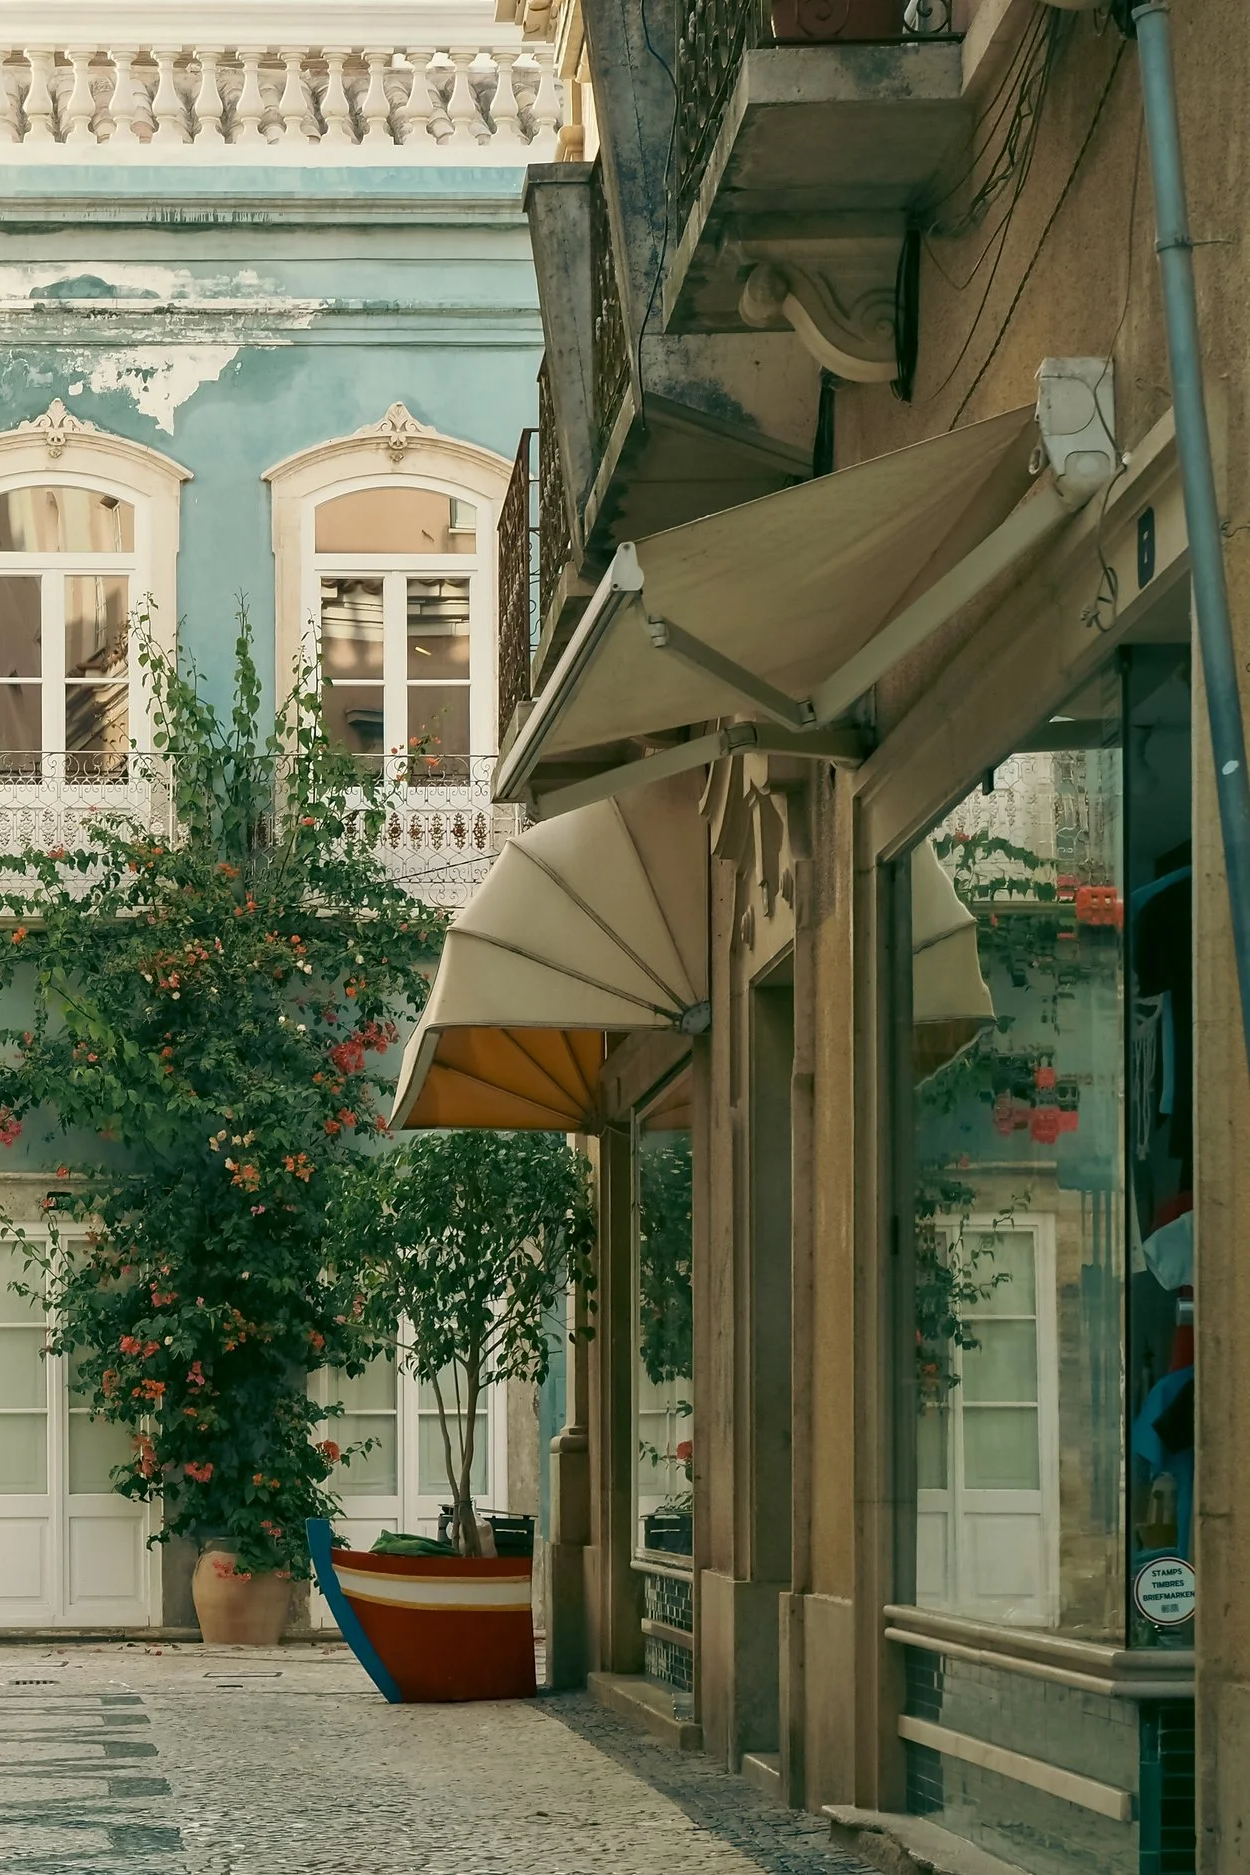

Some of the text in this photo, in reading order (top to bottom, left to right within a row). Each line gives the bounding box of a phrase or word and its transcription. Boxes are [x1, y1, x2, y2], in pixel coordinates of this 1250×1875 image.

[1152, 1568, 1183, 1578] STAMPS
[1152, 1580, 1184, 1589] TIMBRES
[1143, 1591, 1195, 1601] BRIEFMARKEN
